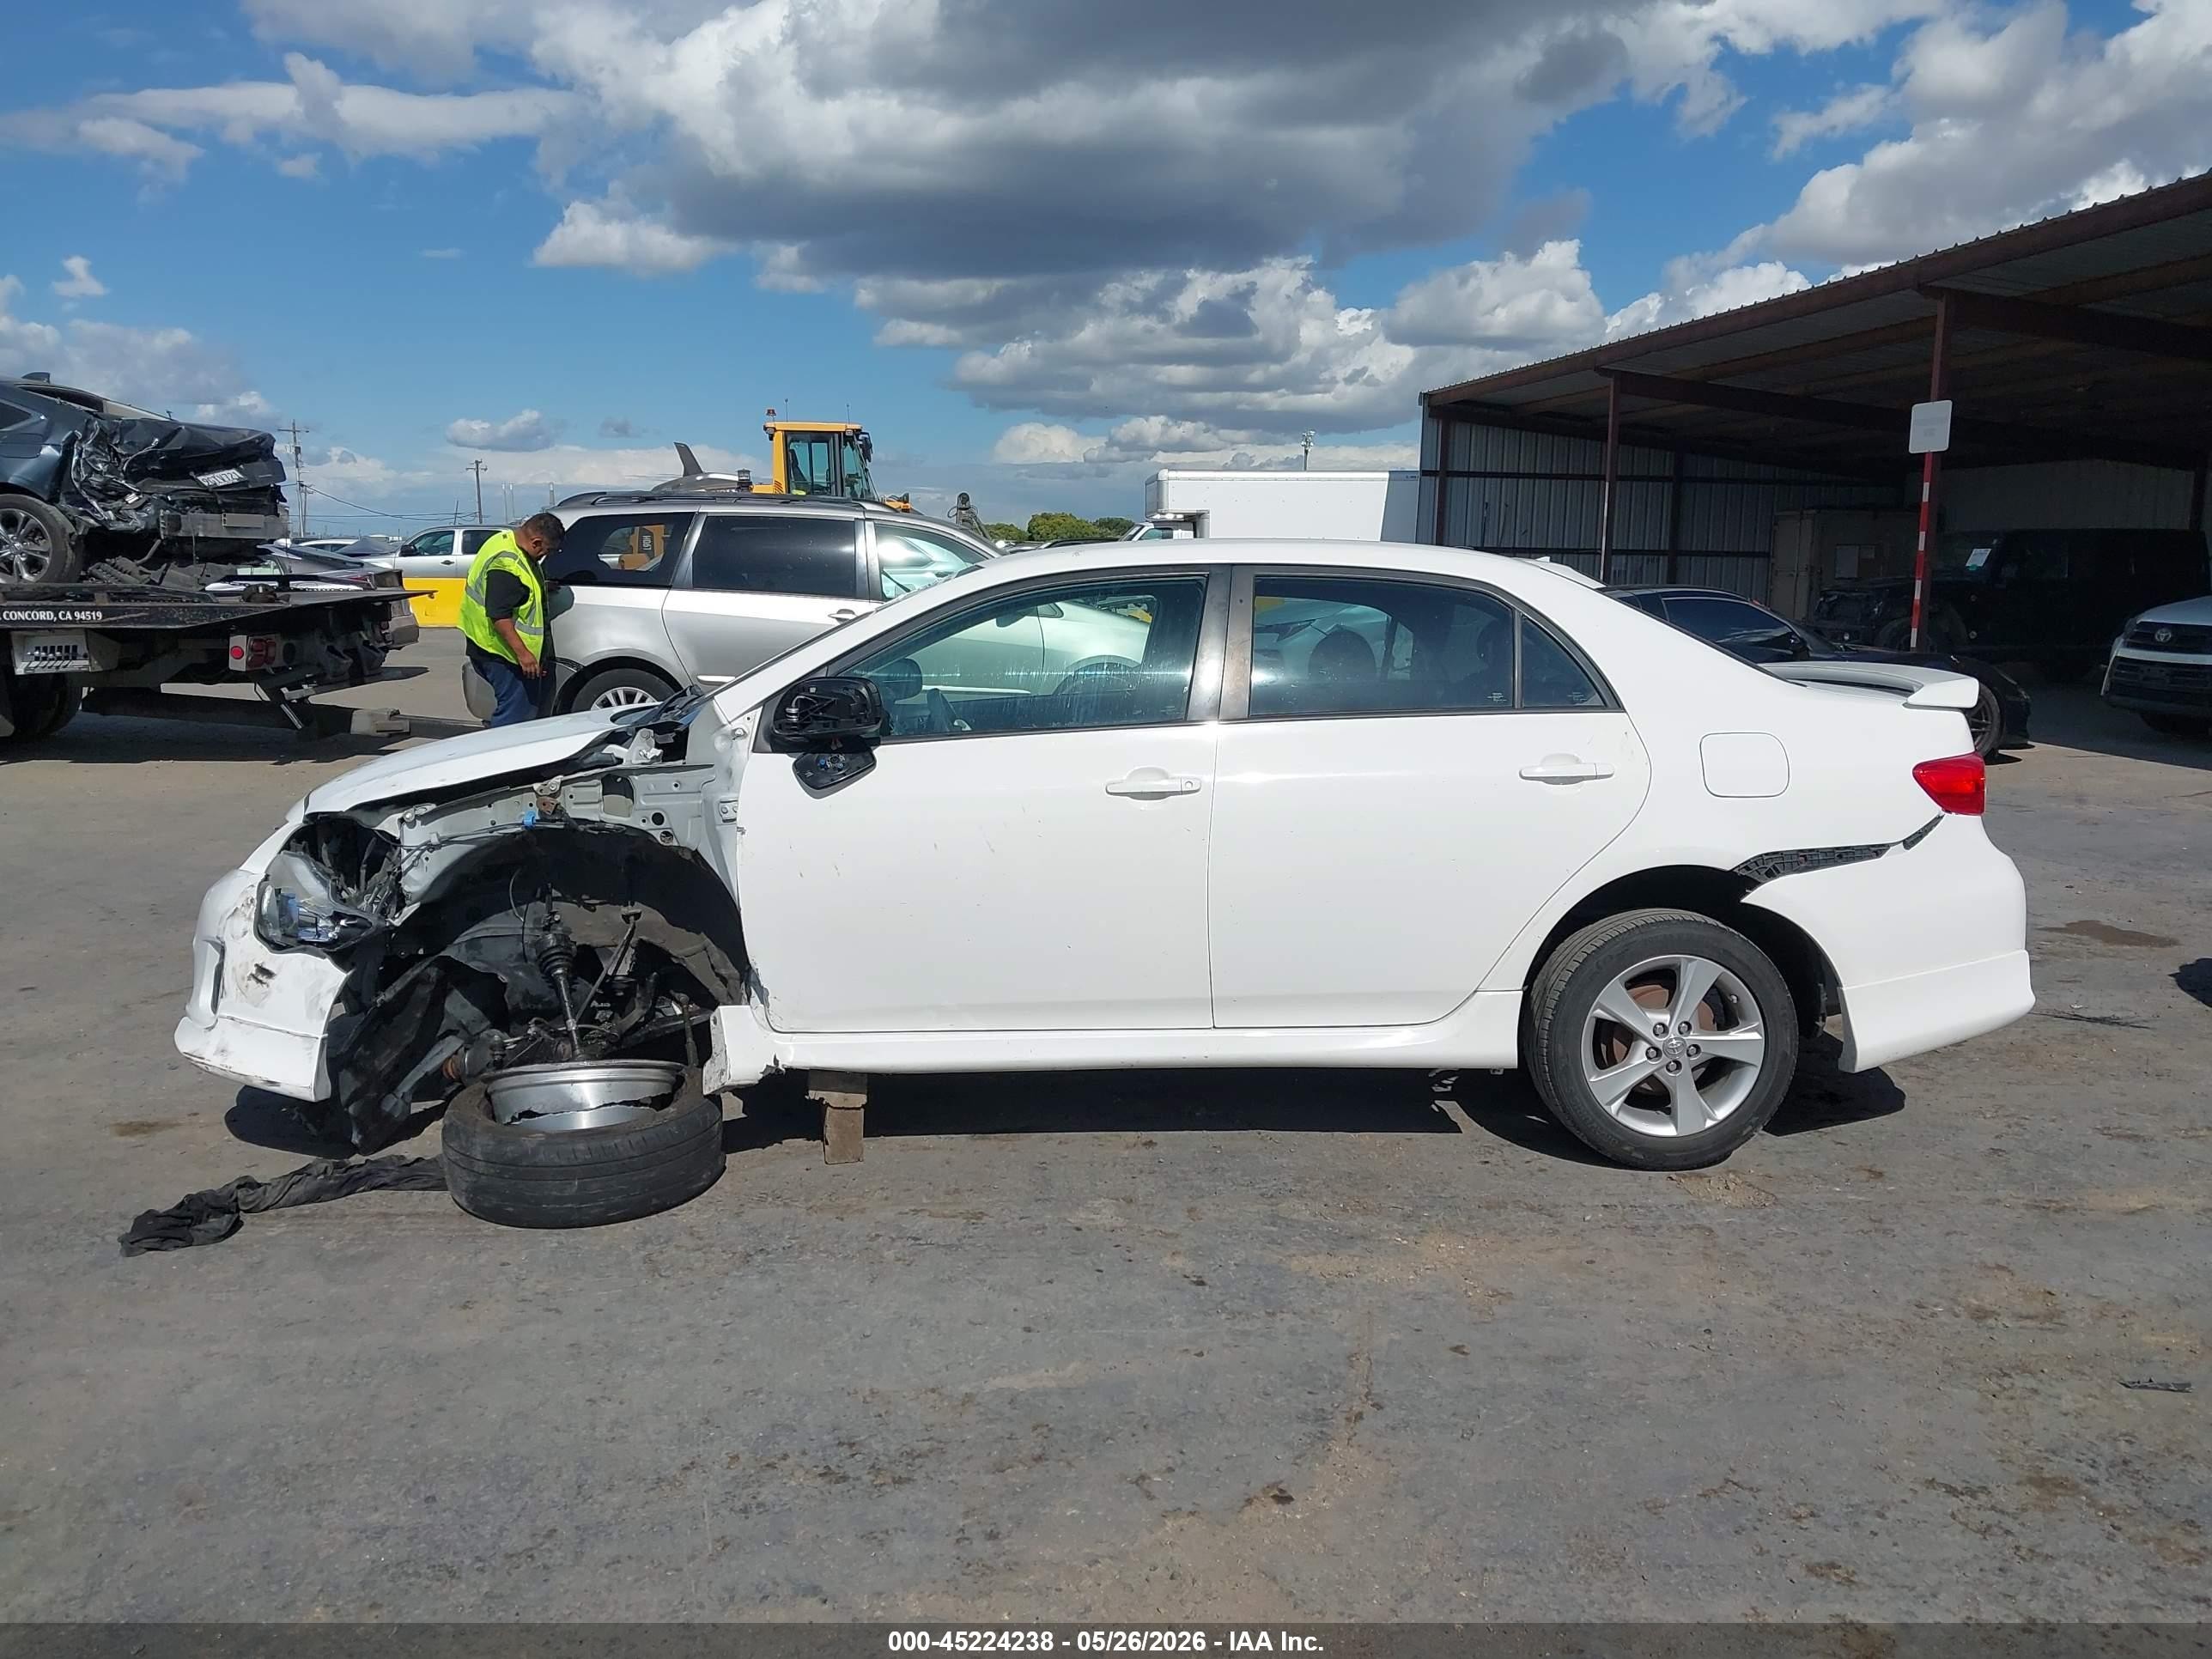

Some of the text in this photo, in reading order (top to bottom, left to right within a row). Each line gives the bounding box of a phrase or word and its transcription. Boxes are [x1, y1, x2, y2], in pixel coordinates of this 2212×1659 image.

[3, 611, 102, 623] CONCORD, CA 94519
